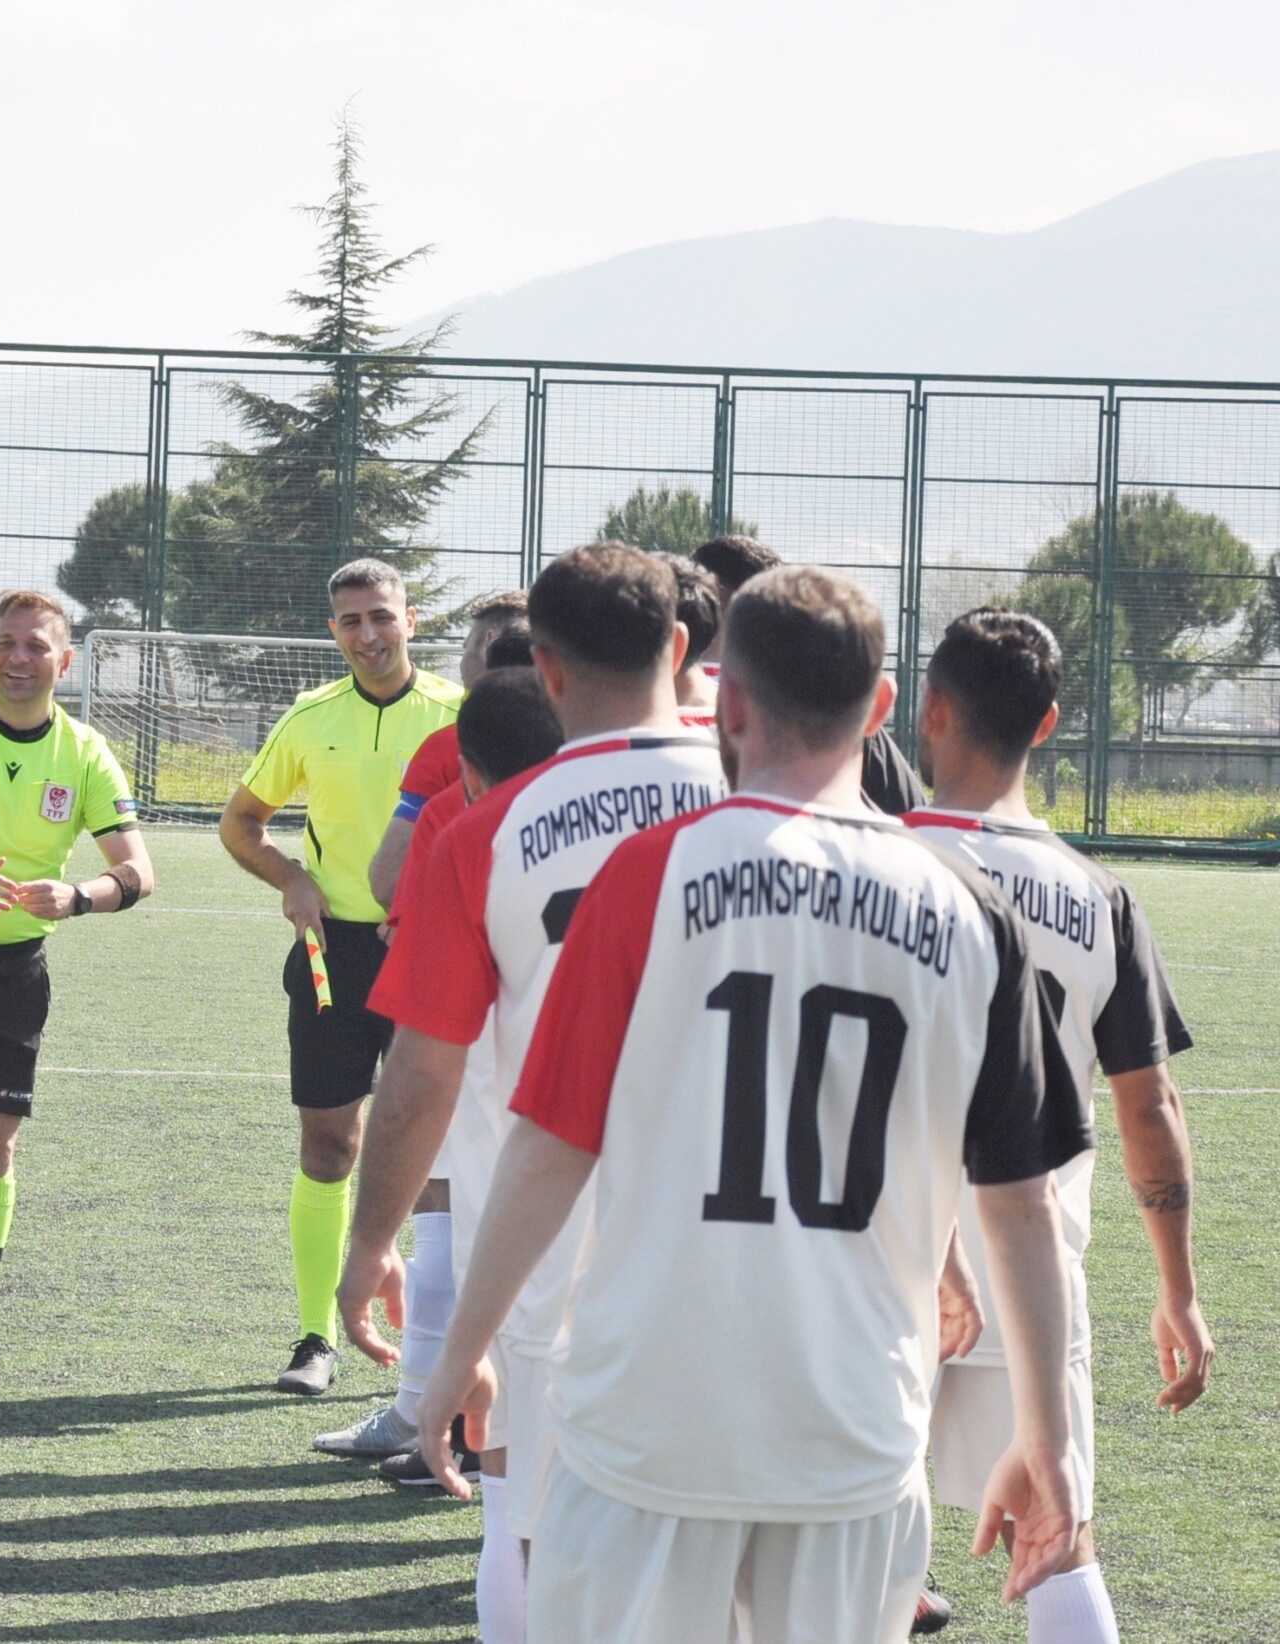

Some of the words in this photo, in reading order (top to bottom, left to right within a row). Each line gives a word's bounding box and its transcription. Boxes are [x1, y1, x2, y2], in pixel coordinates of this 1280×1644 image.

[46, 809, 64, 819] TFF
[520, 783, 664, 873] ROMANSPOR
[683, 857, 840, 941] ROMANSPOR
[849, 876, 956, 978] KULÜBÜ
[1013, 874, 1096, 953] KULÜBÜ
[702, 971, 907, 1232] 10
